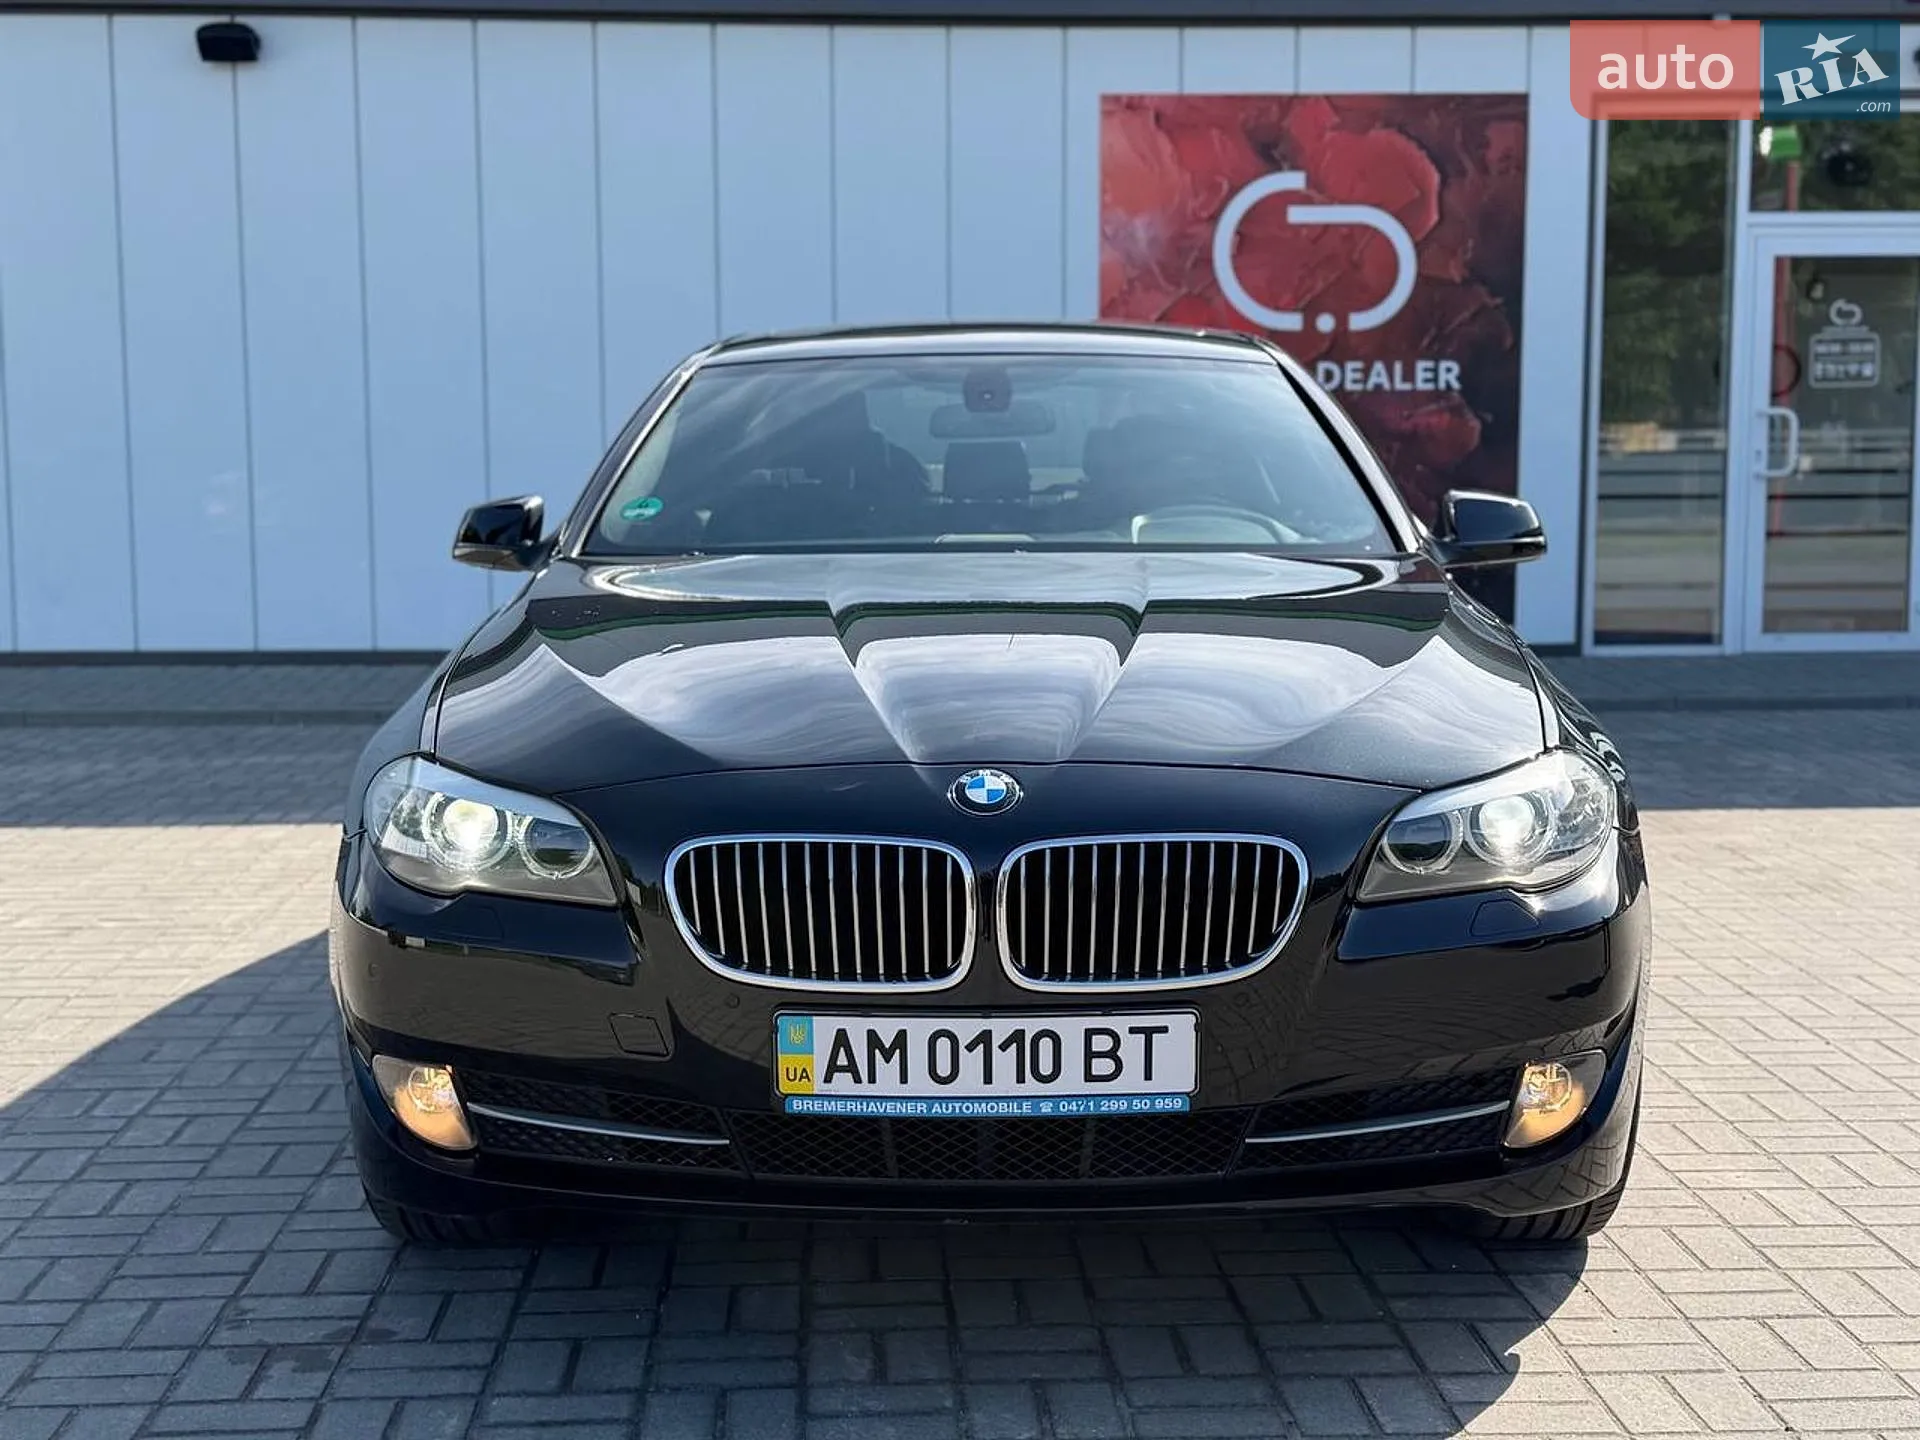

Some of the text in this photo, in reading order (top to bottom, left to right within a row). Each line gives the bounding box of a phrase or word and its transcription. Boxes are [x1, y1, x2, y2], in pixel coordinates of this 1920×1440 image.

[1316, 360, 1462, 391] DEALER
[823, 1026, 1169, 1086] AM 0110 BT
[785, 1066, 811, 1083] UA
[792, 1099, 927, 1114] BREMERHAVENER
[931, 1102, 1032, 1114] AUTOMOBILE
[1100, 1098, 1128, 1111] 299
[1132, 1098, 1151, 1110] 50
[1154, 1097, 1182, 1109] 959
